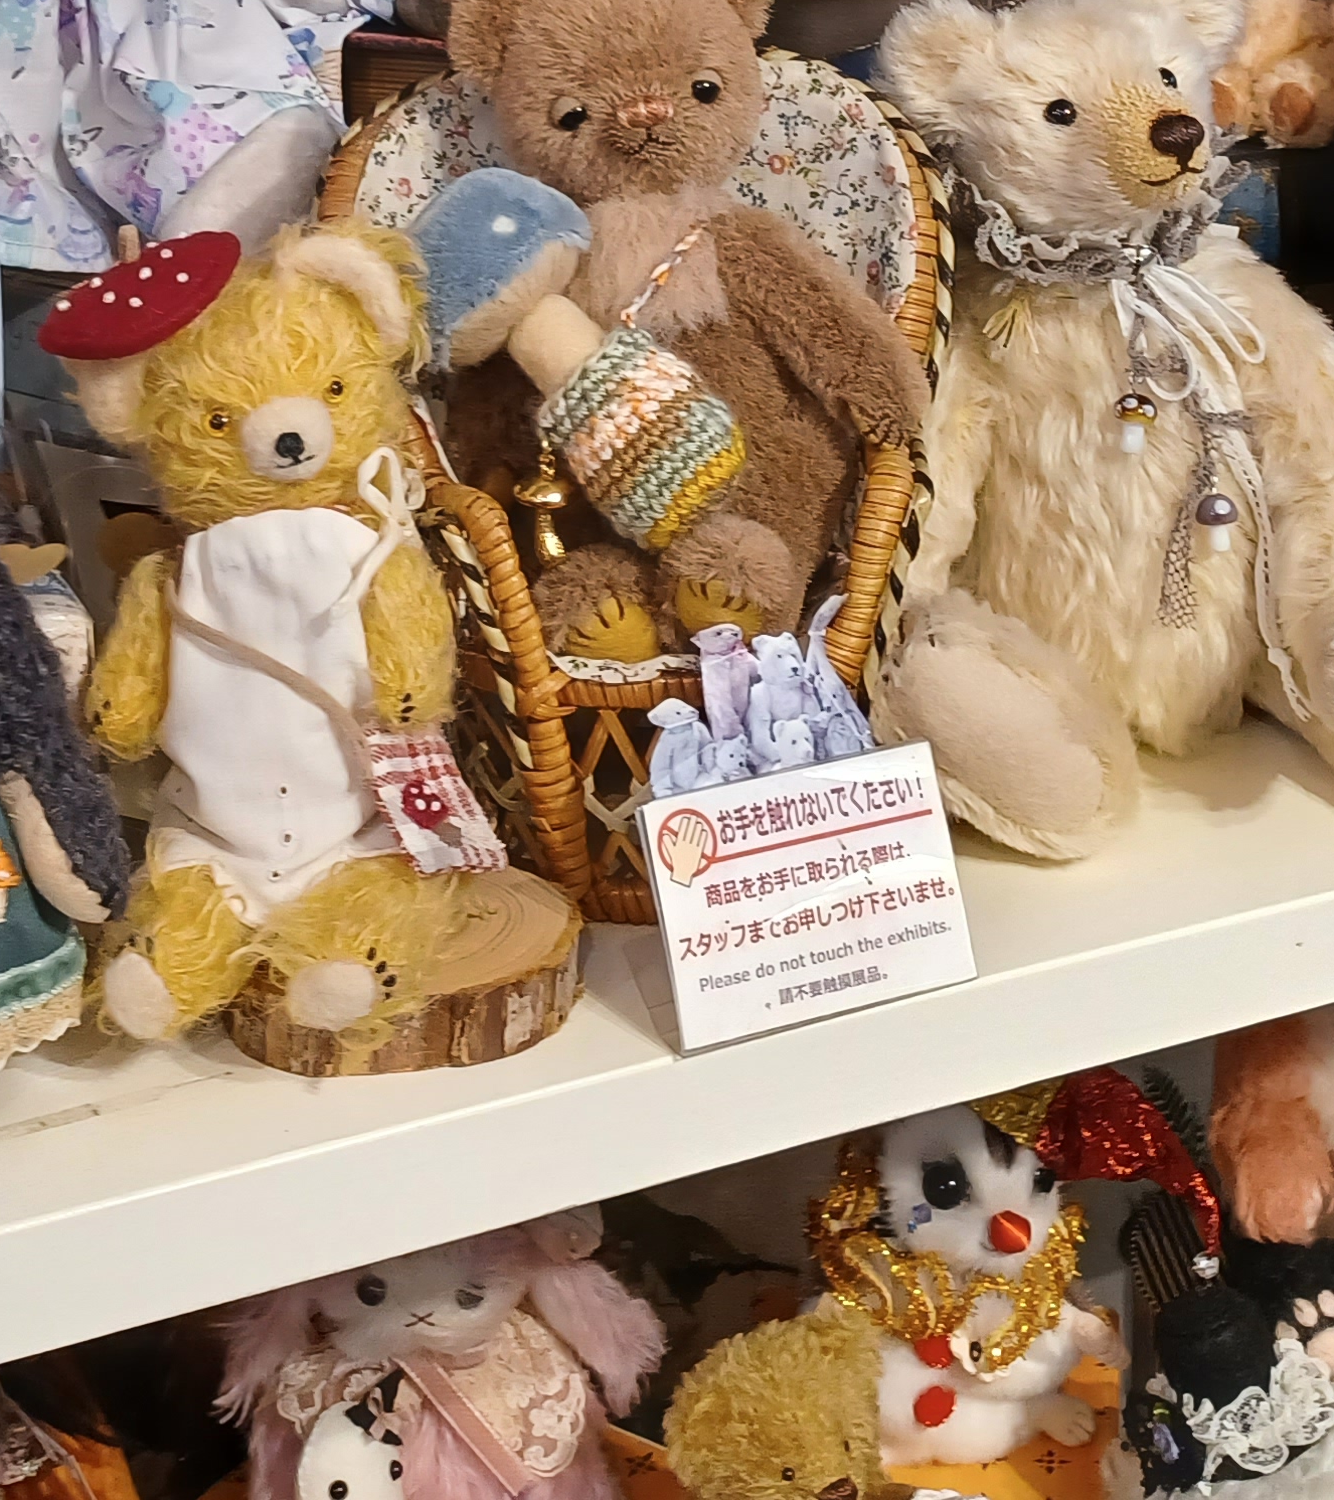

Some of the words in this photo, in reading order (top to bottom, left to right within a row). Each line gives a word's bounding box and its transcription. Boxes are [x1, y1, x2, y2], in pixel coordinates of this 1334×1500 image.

[699, 968, 751, 992] Please
[755, 963, 775, 979] do
[780, 954, 806, 973] not
[810, 943, 854, 966] touch
[857, 936, 883, 953] the
[888, 920, 952, 946] exhibits.
